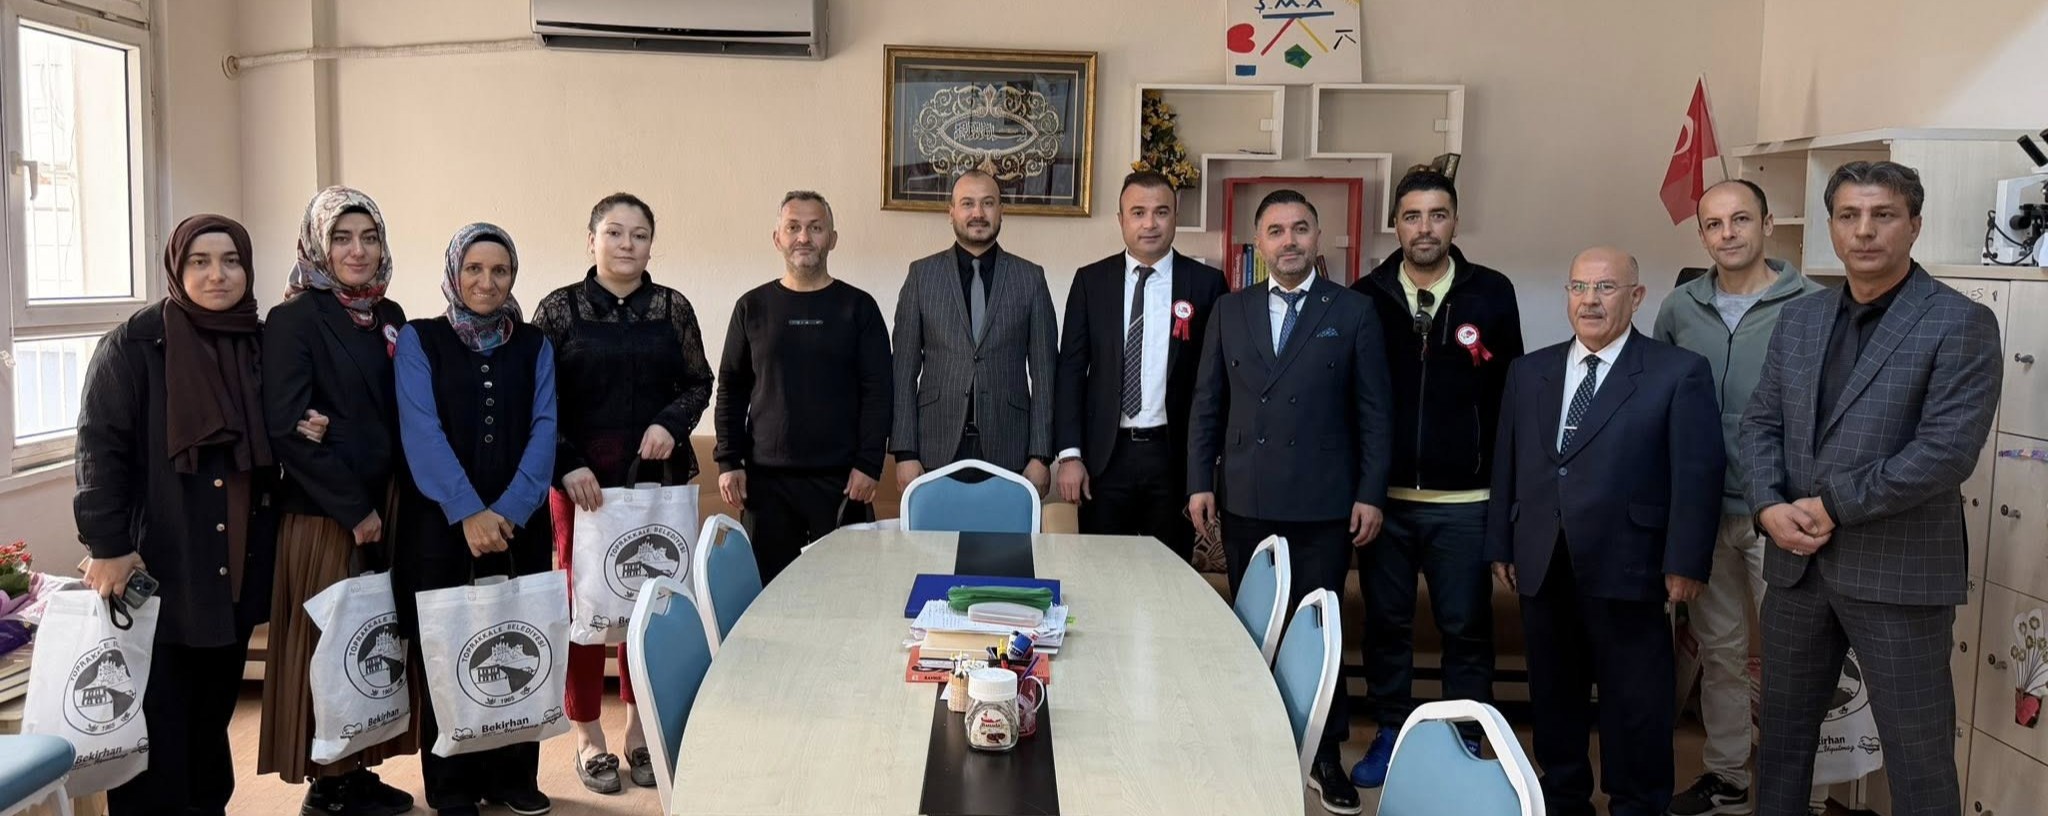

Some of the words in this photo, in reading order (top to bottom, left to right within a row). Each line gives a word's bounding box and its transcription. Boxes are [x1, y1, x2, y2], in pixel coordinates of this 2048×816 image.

[610, 528, 650, 558] TOPRAKKALE
[348, 616, 388, 657] TOPRAKKALE
[461, 627, 503, 663] TOPRAKKALE
[507, 623, 547, 648] BELEDİYESİ
[367, 708, 399, 726] Bekirhan
[481, 717, 529, 733] Bekirhan
[75, 746, 122, 764] Bekirhan
